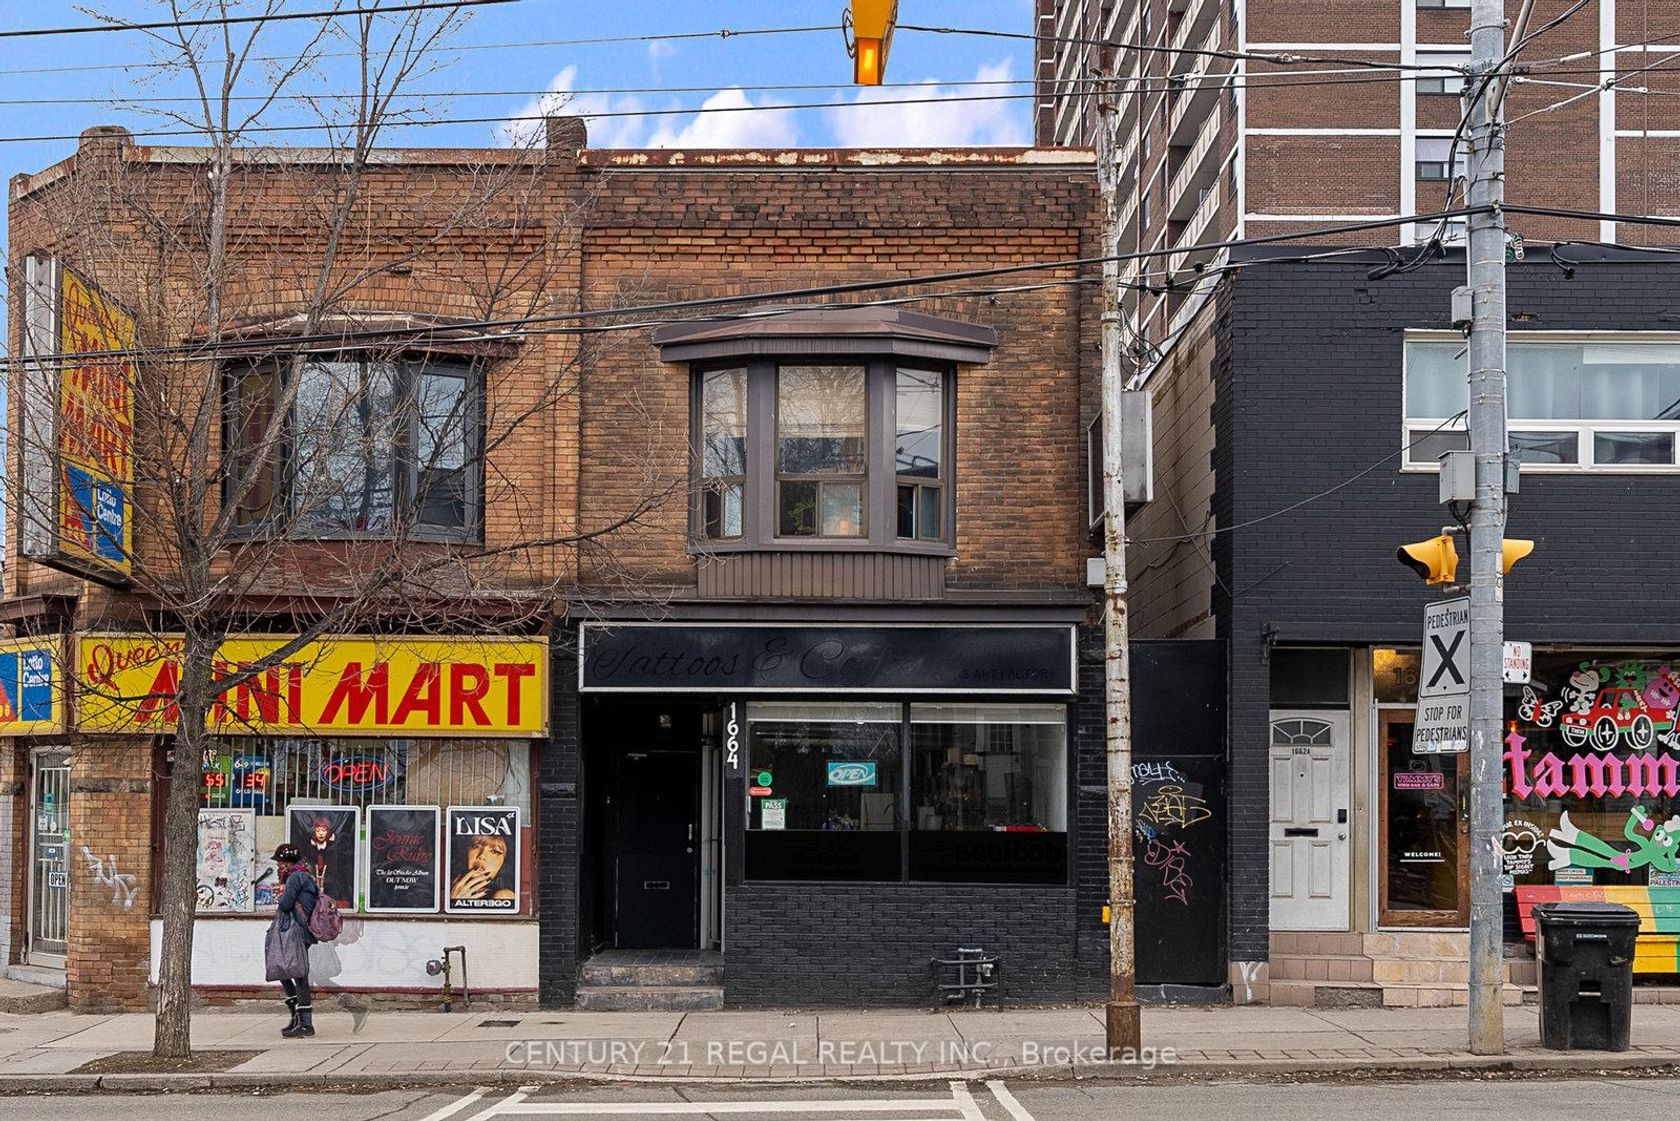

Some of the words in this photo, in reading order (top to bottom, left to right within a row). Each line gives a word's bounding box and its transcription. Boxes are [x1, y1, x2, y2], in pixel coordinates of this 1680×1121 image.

[1428, 609, 1468, 629] PEDESTRIAN
[593, 646, 738, 681] Tattoos
[752, 637, 794, 682] &
[1426, 630, 1466, 687] X
[1513, 646, 1521, 657] NO
[1504, 658, 1529, 670] STANDING
[317, 661, 536, 726] MART
[1424, 707, 1443, 721] STOP
[1447, 706, 1462, 720] FOR
[726, 702, 739, 769] 1664
[1417, 726, 1467, 743] PEDESTRIANS
[323, 761, 389, 783] OPEN
[829, 768, 868, 782] OPEN
[765, 801, 783, 809] PASS
[455, 816, 512, 836] LISA
[50, 873, 66, 886] OPEN
